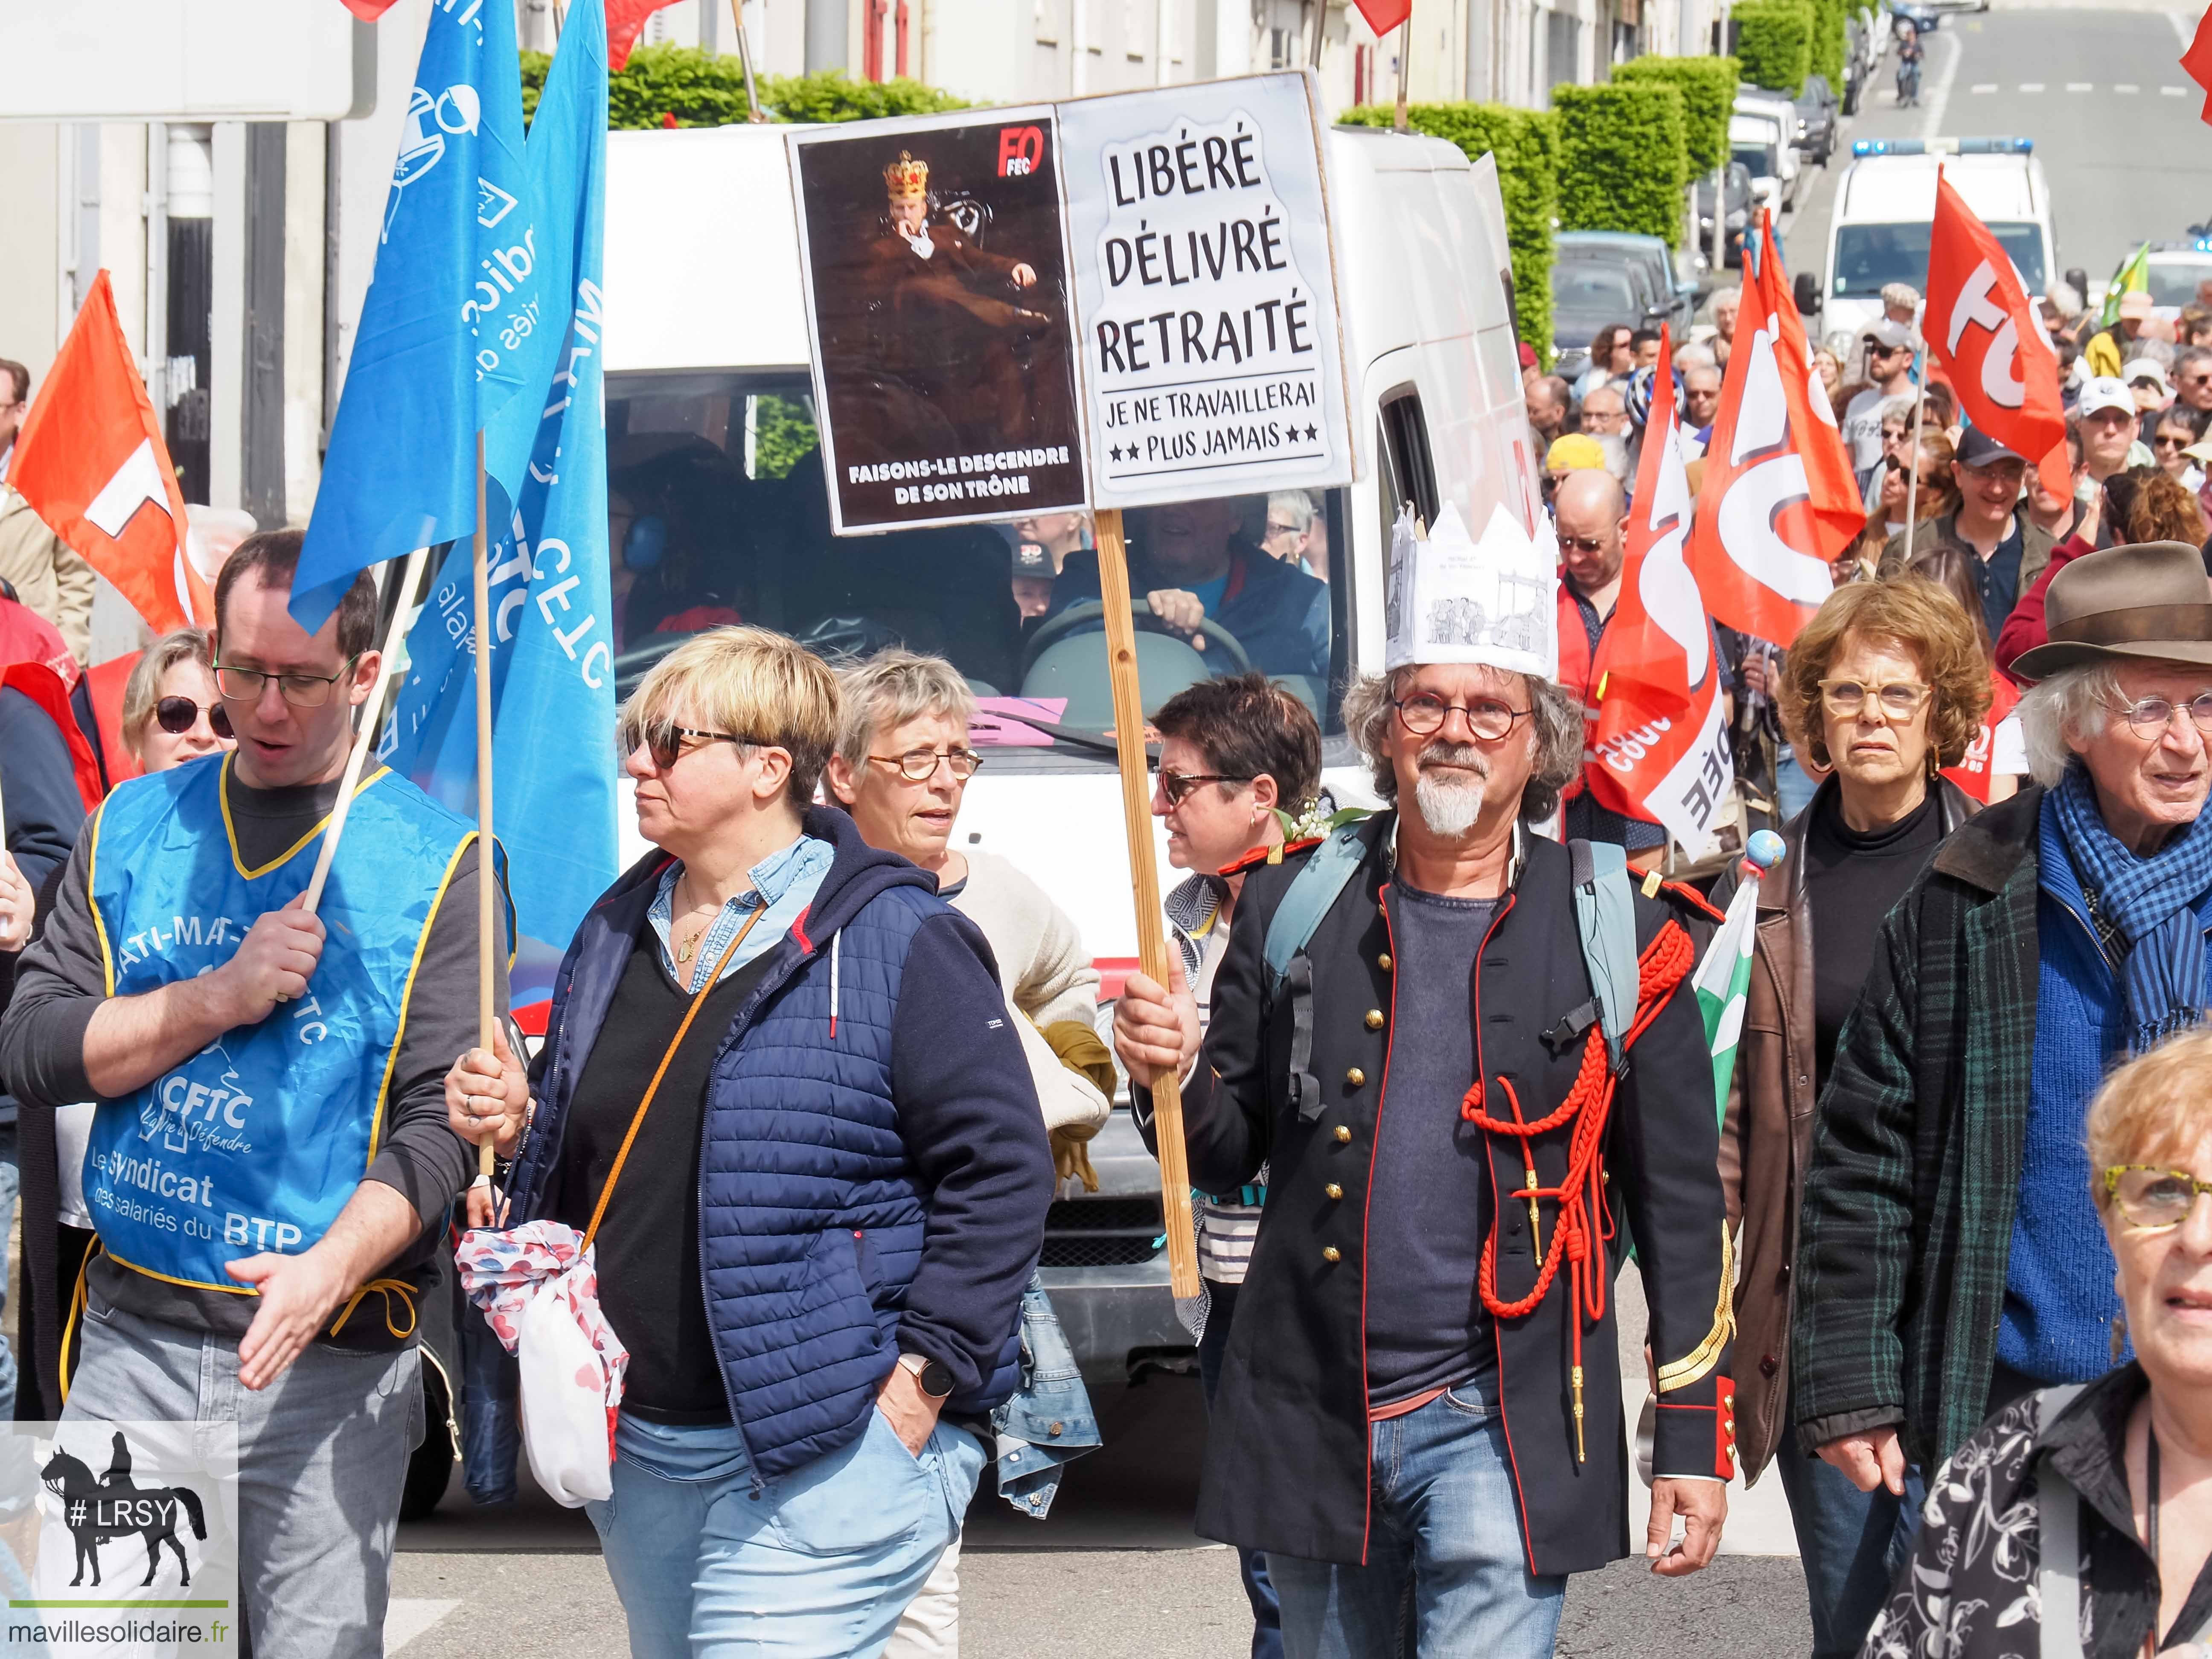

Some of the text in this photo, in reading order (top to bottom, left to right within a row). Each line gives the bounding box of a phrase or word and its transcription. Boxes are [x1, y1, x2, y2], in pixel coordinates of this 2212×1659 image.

[998, 125, 1043, 178] FO
[1007, 157, 1031, 176] FEC
[1110, 122, 1260, 207] LIBÉRÉ
[1106, 205, 1286, 287] DÉLIVRÉ
[1097, 288, 1313, 373] RETRAITÉ
[1106, 382, 1316, 428] JE NE TRAVAILLERAI
[848, 446, 1069, 484] FAISONS-LE DESCENDRE
[1147, 422, 1280, 461] PLUS JAMAIS
[895, 473, 1030, 505] DE SON TRÔNE
[114, 916, 250, 988] ATI-MAT-
[163, 1076, 253, 1129] CFTC
[189, 1121, 252, 1153] Défendre
[92, 1146, 214, 1208] Le syndicat
[94, 1187, 302, 1253] des salariés du BTP
